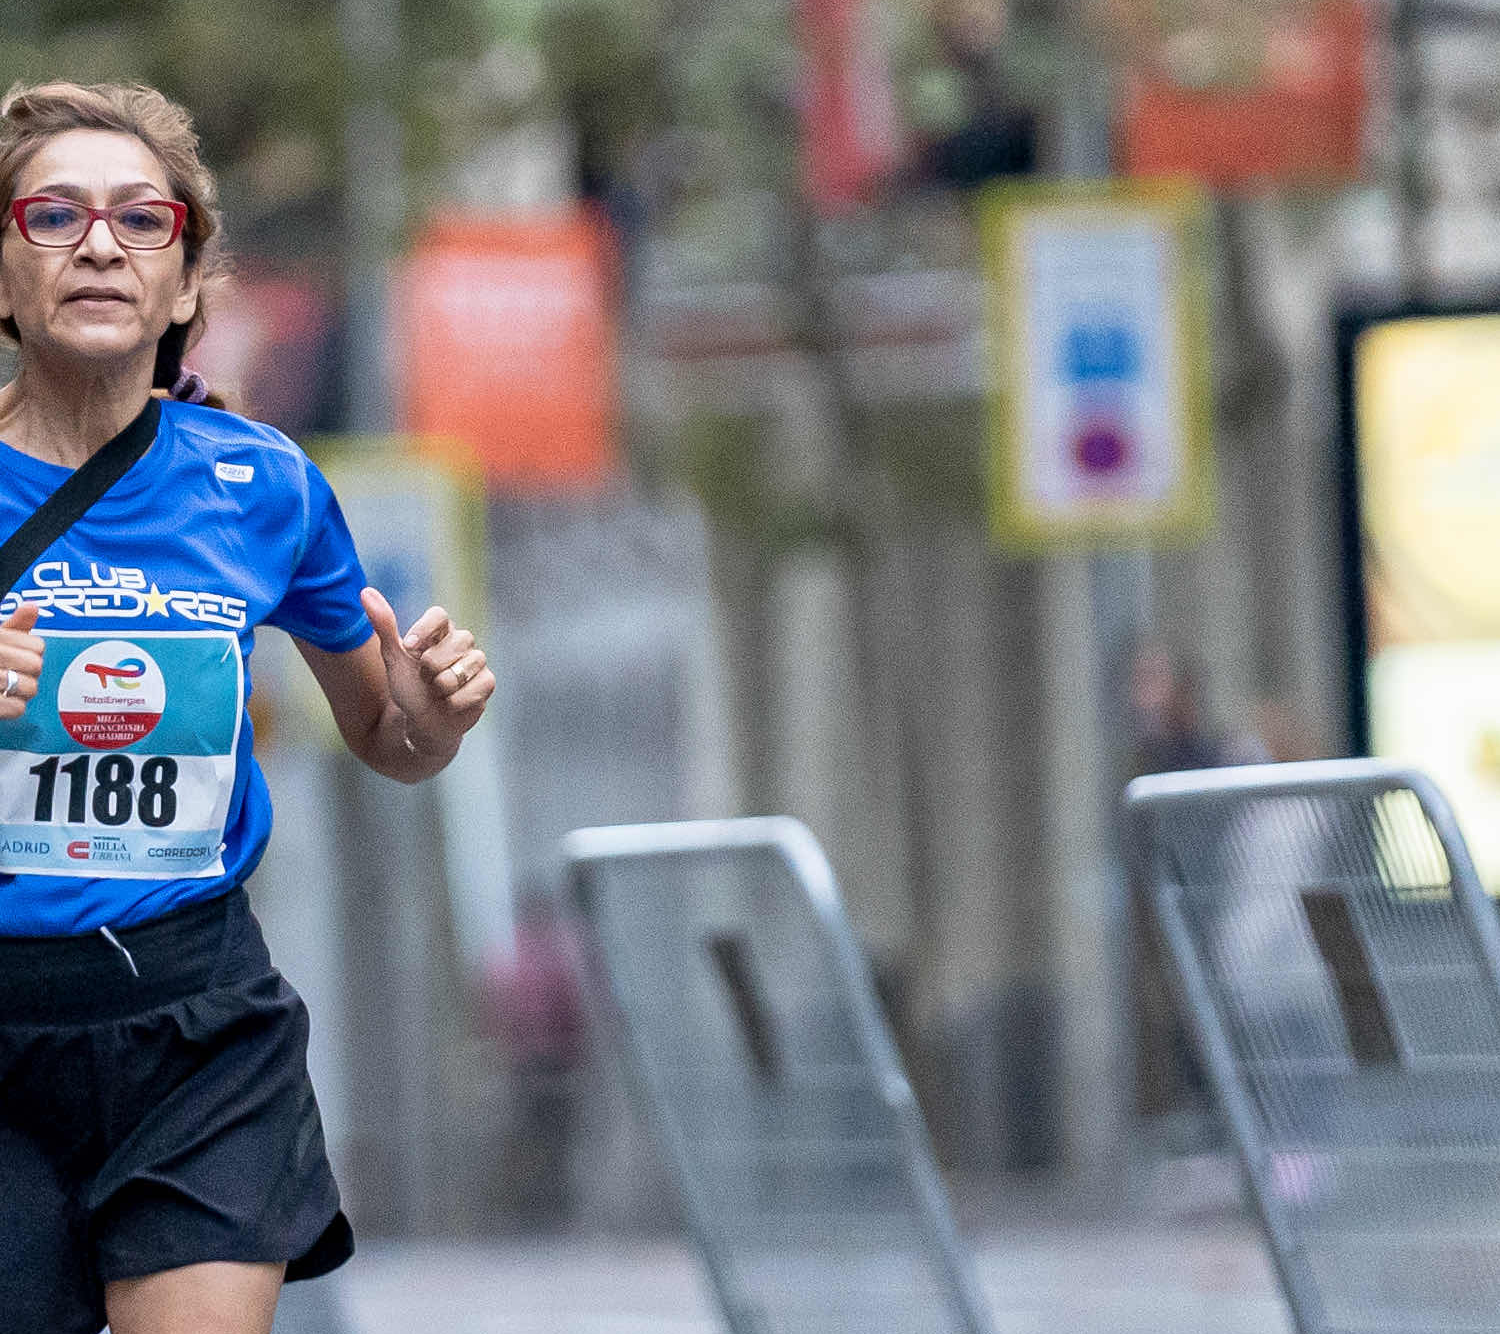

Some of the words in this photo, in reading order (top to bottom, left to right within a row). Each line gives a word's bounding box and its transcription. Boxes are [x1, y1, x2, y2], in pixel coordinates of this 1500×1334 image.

[33, 562, 147, 589] CLUB
[29, 754, 178, 828] 1188
[93, 842, 127, 852] MILLA
